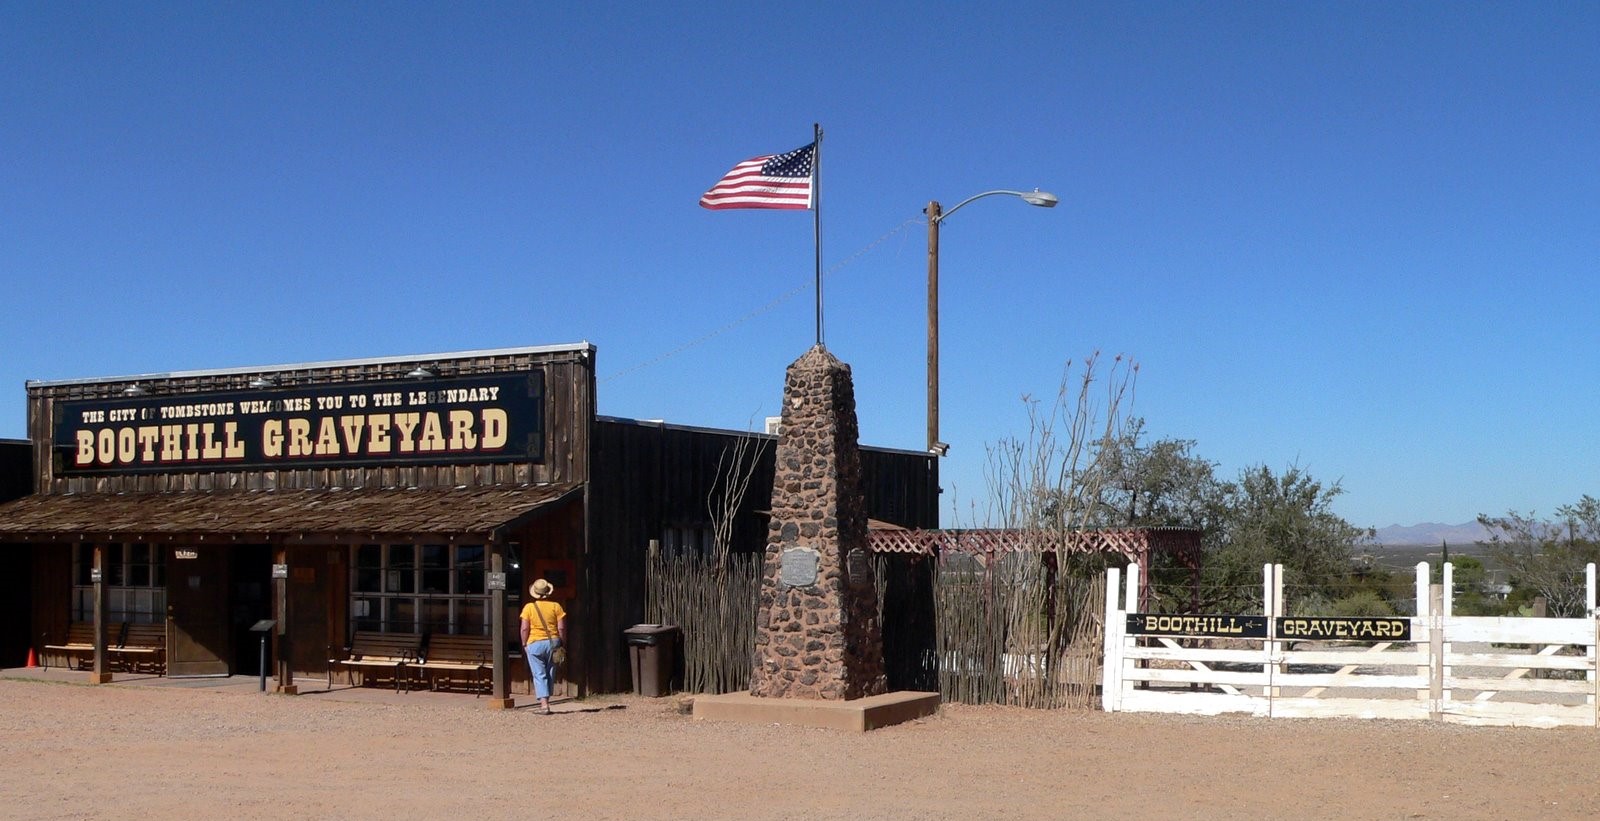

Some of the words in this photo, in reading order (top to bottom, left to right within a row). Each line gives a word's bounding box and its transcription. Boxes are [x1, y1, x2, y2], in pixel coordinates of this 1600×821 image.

[82, 411, 105, 424] THE
[109, 408, 137, 422] CITY
[141, 407, 156, 420] OF
[160, 402, 235, 419] TOMBSTONE
[239, 397, 312, 415] WELCOMES
[317, 396, 344, 411] YOU
[349, 394, 367, 409] TO
[373, 392, 403, 407] THE
[408, 386, 500, 406] LEGENDARY
[76, 421, 245, 465] BOOTHILL
[263, 407, 508, 458] GRAVEYARD
[1144, 615, 1243, 634] BOOTHILL
[1283, 619, 1404, 637] GRAVEYARD
